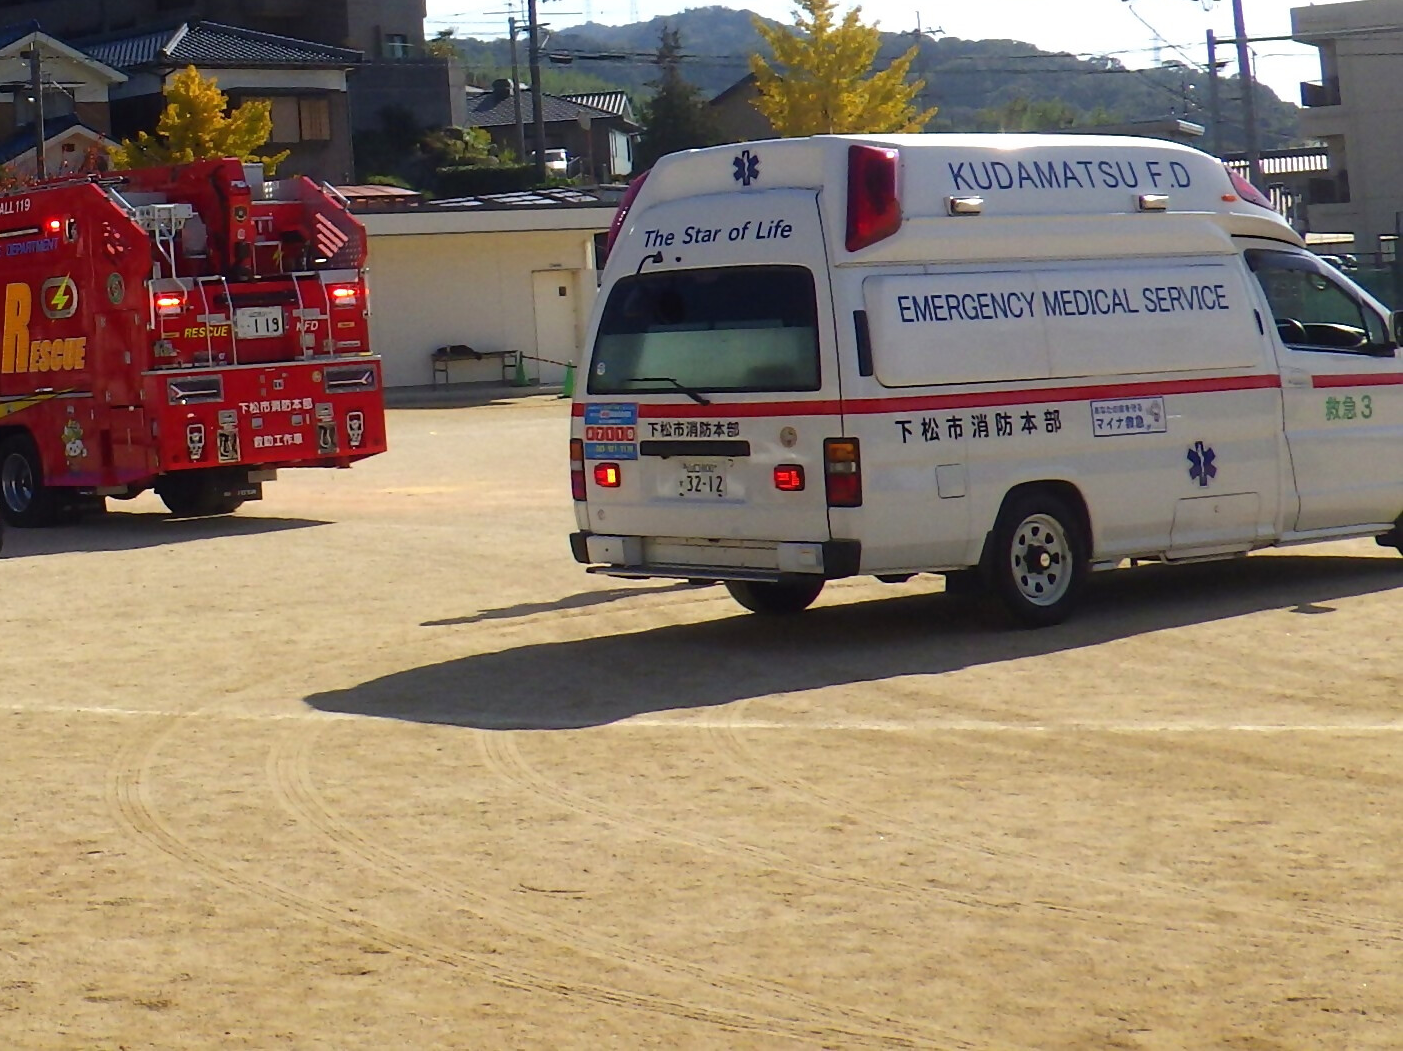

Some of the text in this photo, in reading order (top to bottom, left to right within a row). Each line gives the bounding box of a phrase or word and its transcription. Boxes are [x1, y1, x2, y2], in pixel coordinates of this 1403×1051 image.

[947, 161, 1139, 191] KUDAMATSU
[15, 198, 31, 213] 119
[644, 219, 793, 248] The Star of Life
[5, 238, 59, 256] DEPARTMENT
[897, 284, 1230, 323] EMERGENCY MEDICAL SERVICE
[184, 325, 229, 338] RESCUE
[254, 317, 280, 333] 119
[647, 421, 740, 438] 下松市消防本部
[894, 409, 1063, 444] 下松市消防本部
[686, 475, 723, 493] 32-12
